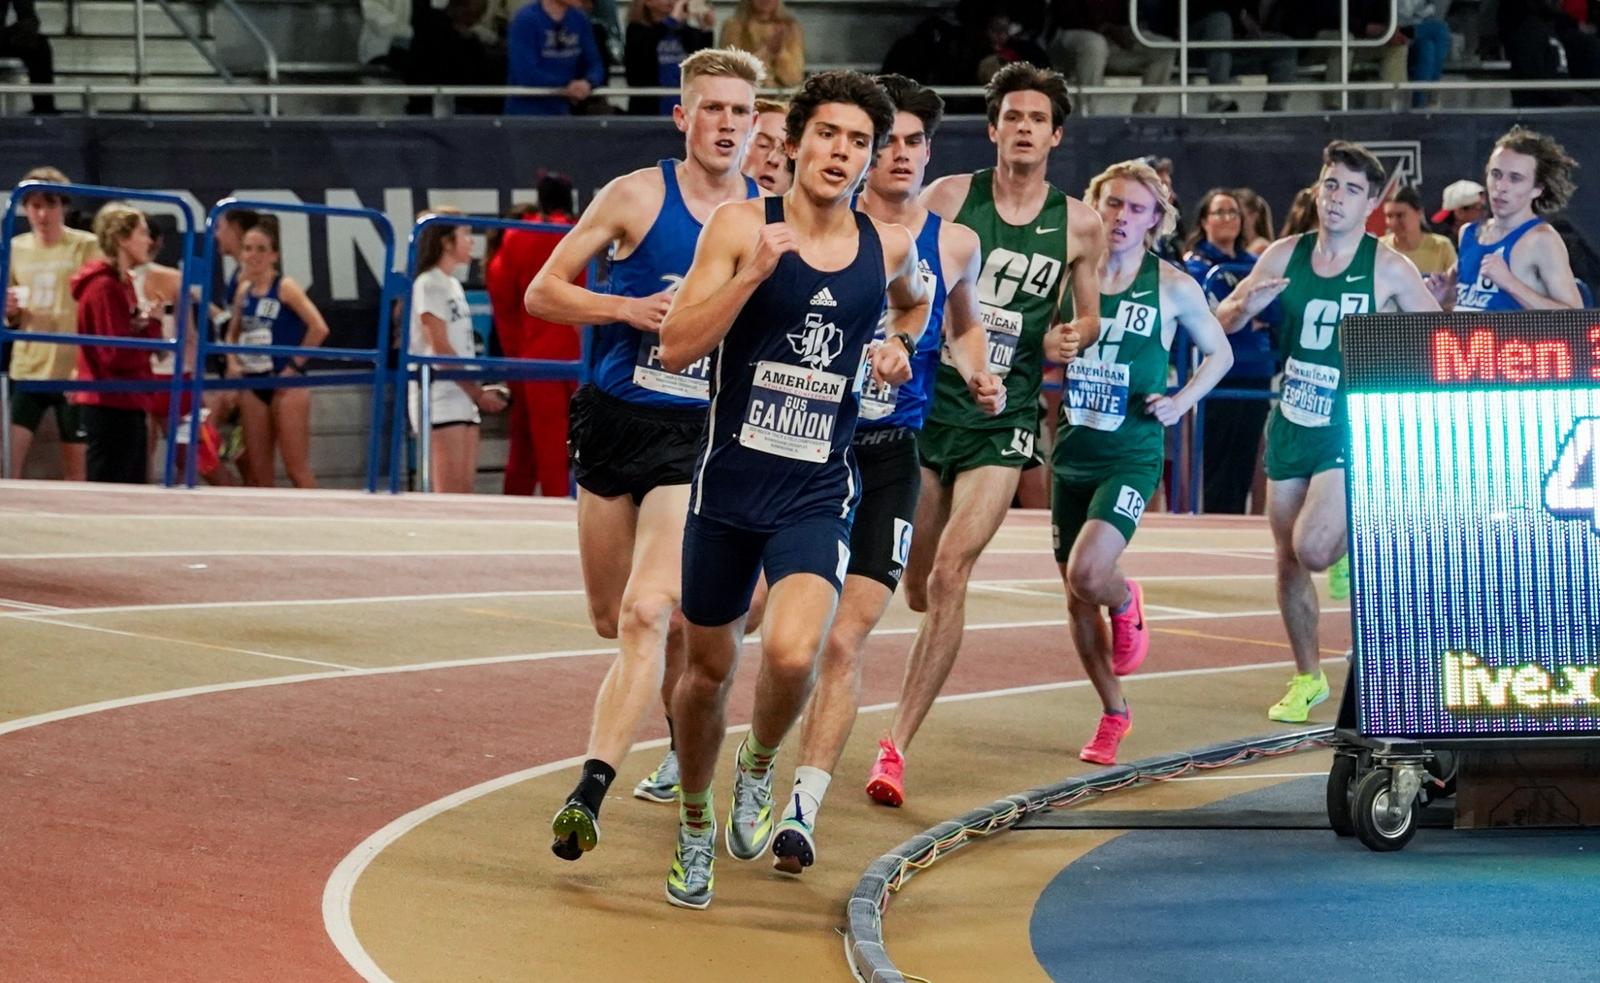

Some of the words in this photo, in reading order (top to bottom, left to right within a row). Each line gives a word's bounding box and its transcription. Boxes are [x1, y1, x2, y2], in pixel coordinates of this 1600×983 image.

[1030, 261, 1053, 294] 4
[810, 298, 837, 307] adidas
[981, 312, 1018, 331] RICAN
[1124, 304, 1149, 332] 18
[1434, 328, 1571, 382] Men
[761, 370, 840, 396] AMERICAN
[1068, 364, 1125, 382] AMERICAN
[785, 395, 808, 412] GUS
[1068, 389, 1121, 414] WHITE
[1282, 385, 1333, 416] ESPOSITO
[749, 400, 834, 441] GANNON
[1018, 429, 1030, 453] 4
[1127, 491, 1143, 519] 18
[899, 524, 909, 564] 6
